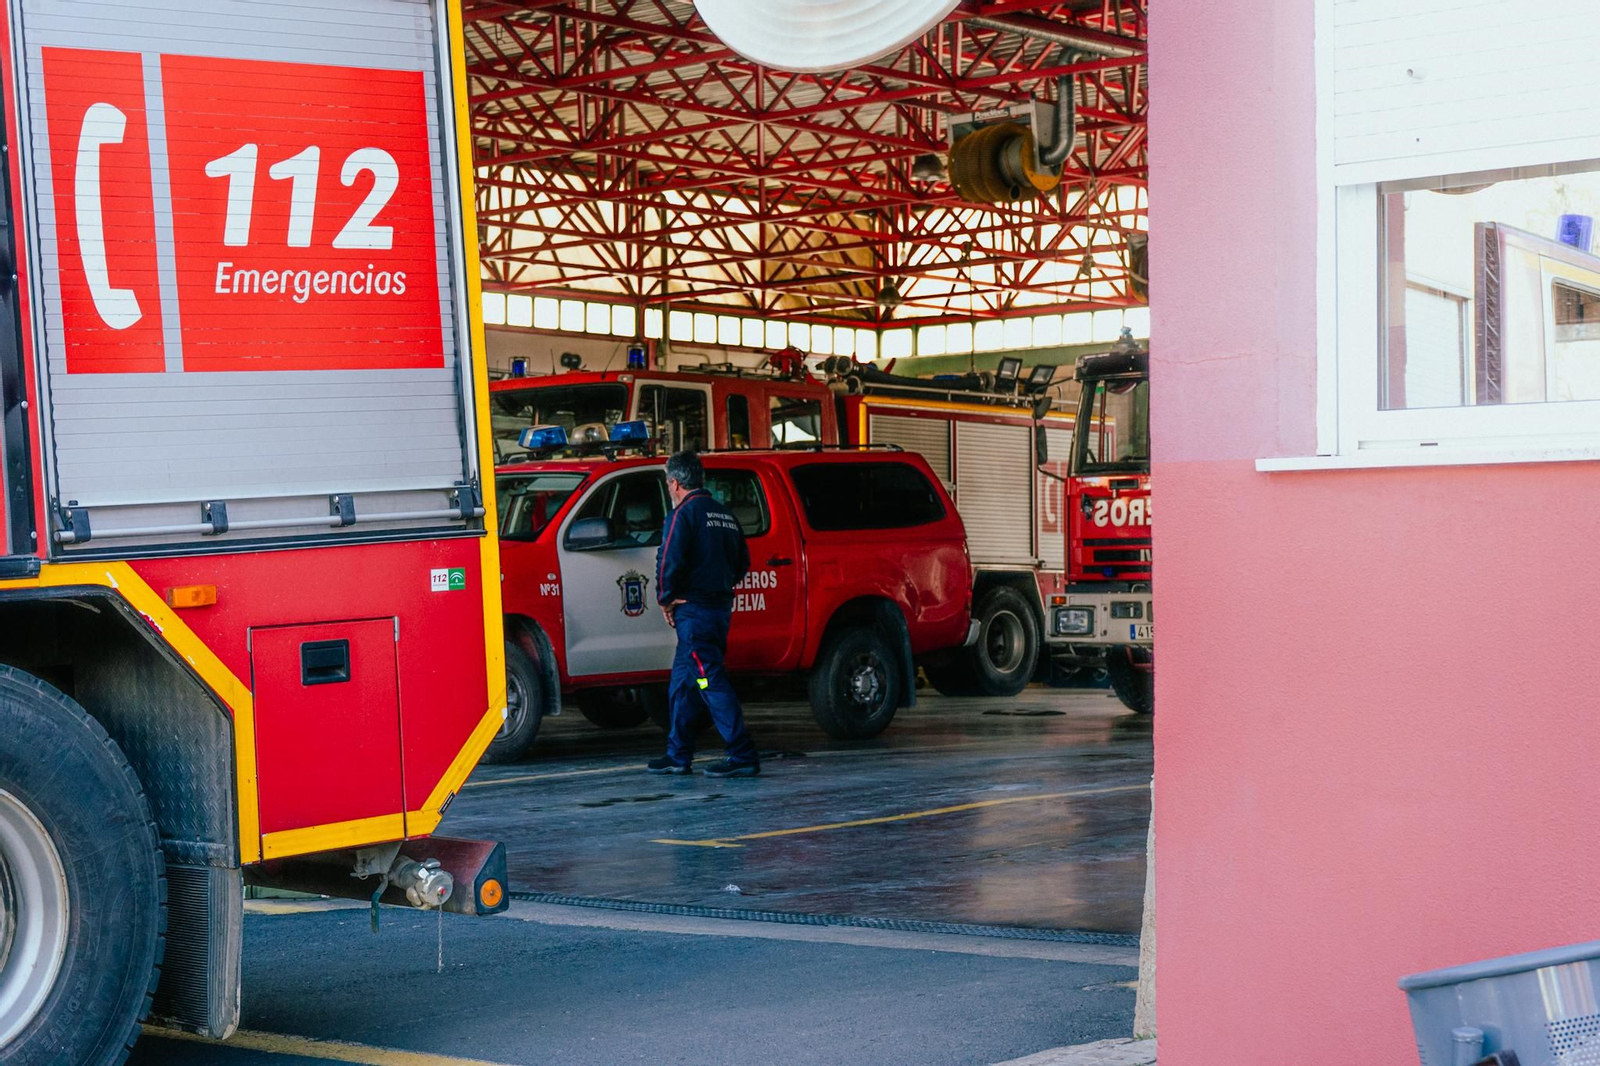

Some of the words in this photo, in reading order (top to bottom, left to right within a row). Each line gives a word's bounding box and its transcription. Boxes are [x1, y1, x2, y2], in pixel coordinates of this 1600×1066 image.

[205, 143, 399, 250] 112
[215, 262, 406, 303] Emergencias
[432, 573, 448, 583] 112
